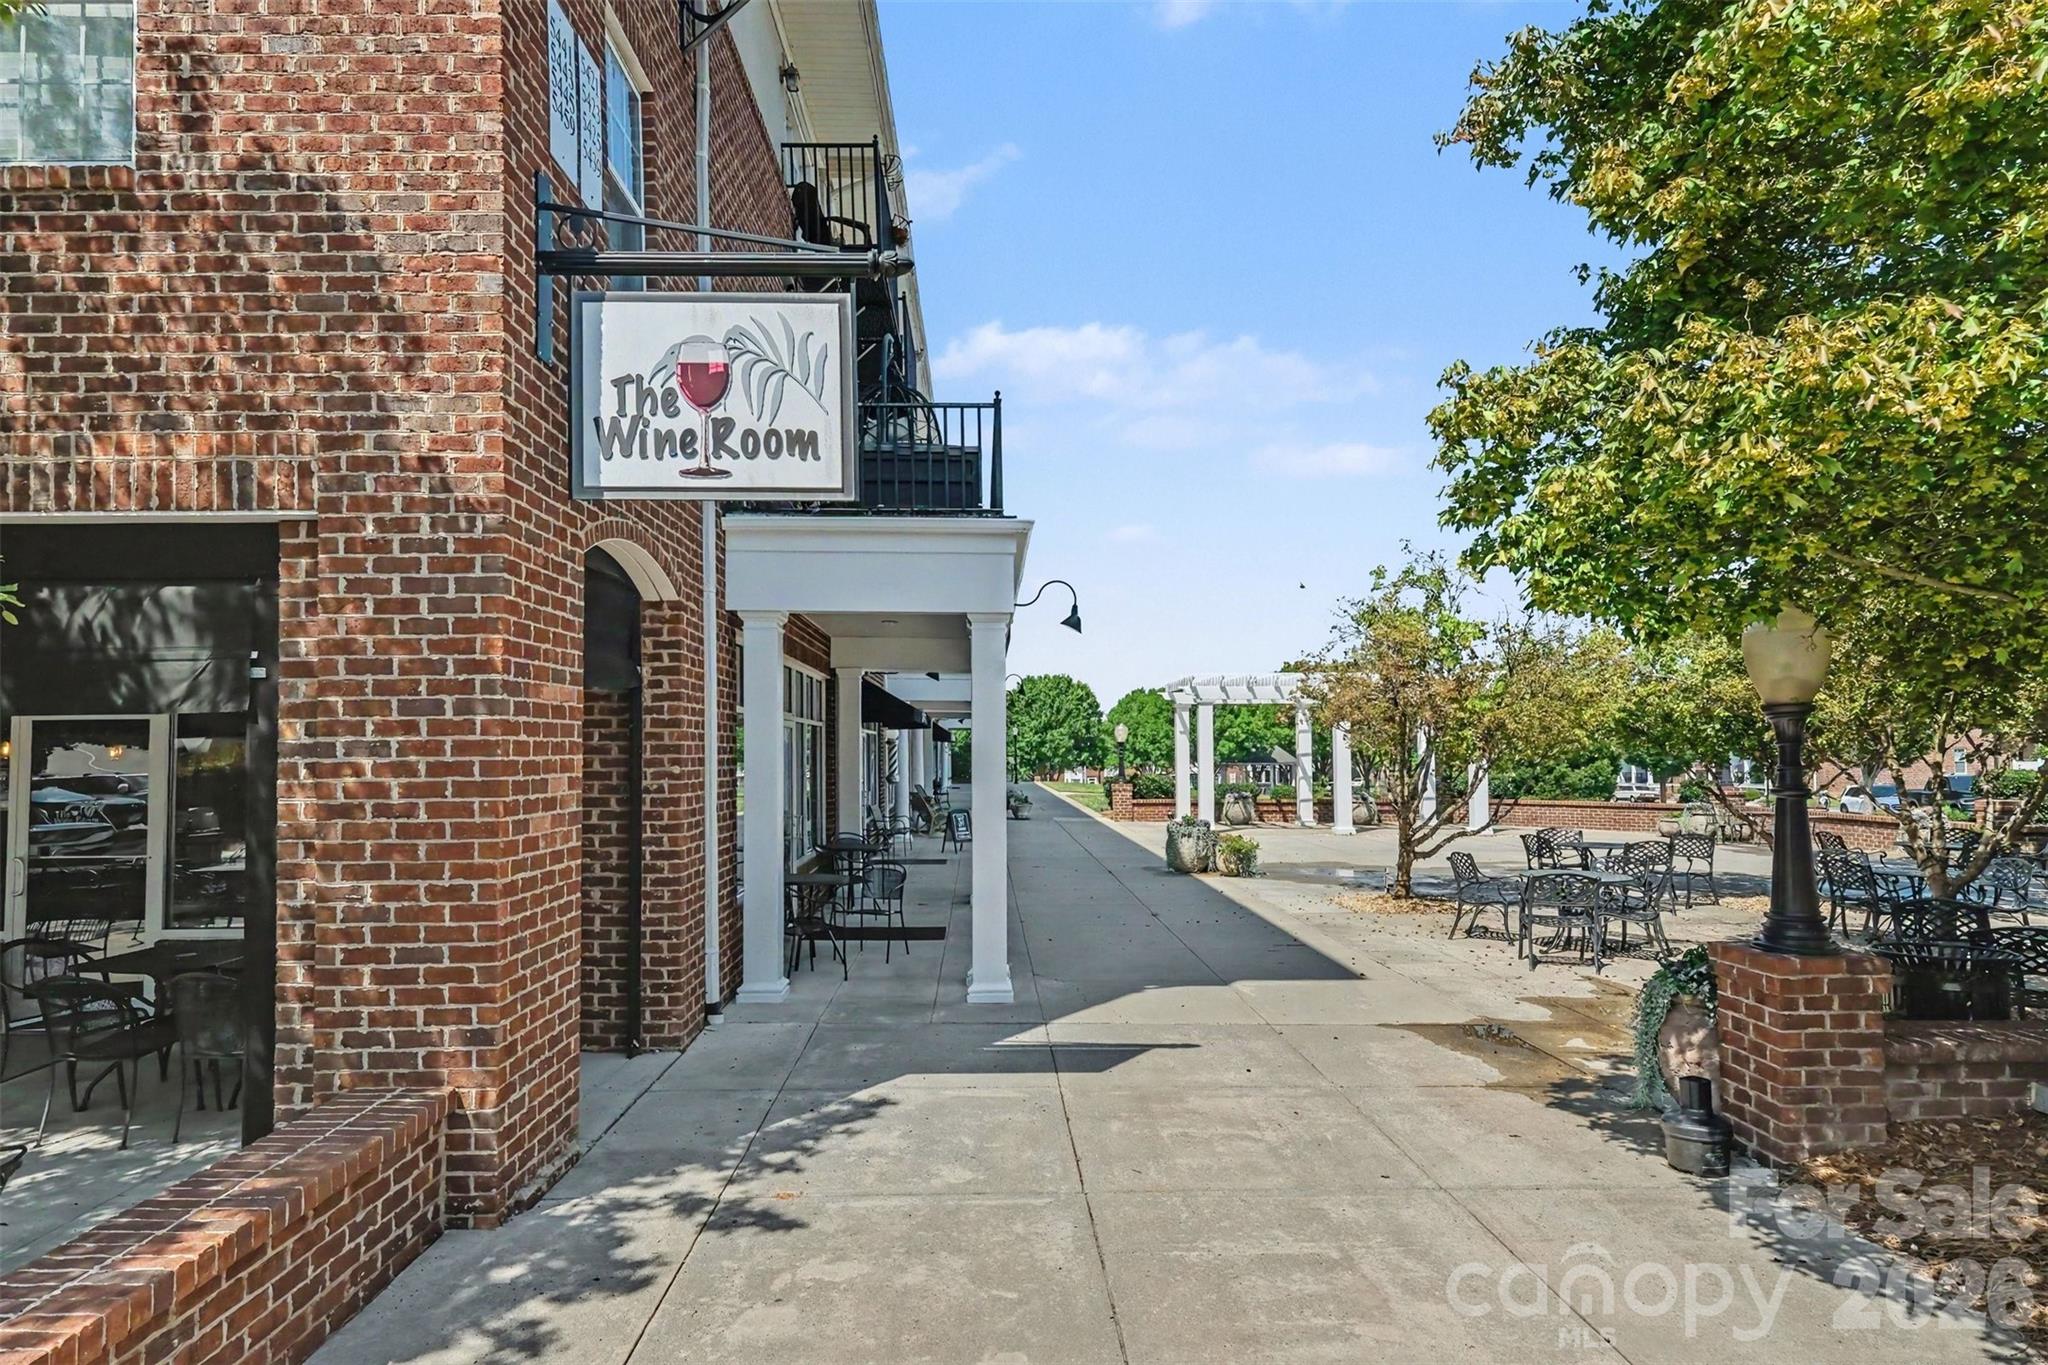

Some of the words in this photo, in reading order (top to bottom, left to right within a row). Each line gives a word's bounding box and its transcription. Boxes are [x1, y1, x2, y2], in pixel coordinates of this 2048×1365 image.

[550, 16, 572, 66] 5441
[550, 41, 574, 90] 5443
[581, 55, 600, 97] 5421
[551, 65, 575, 115] 5445
[552, 90, 576, 136] 5459
[610, 373, 681, 418] The
[593, 415, 699, 461] Wine
[710, 416, 821, 461] Room
